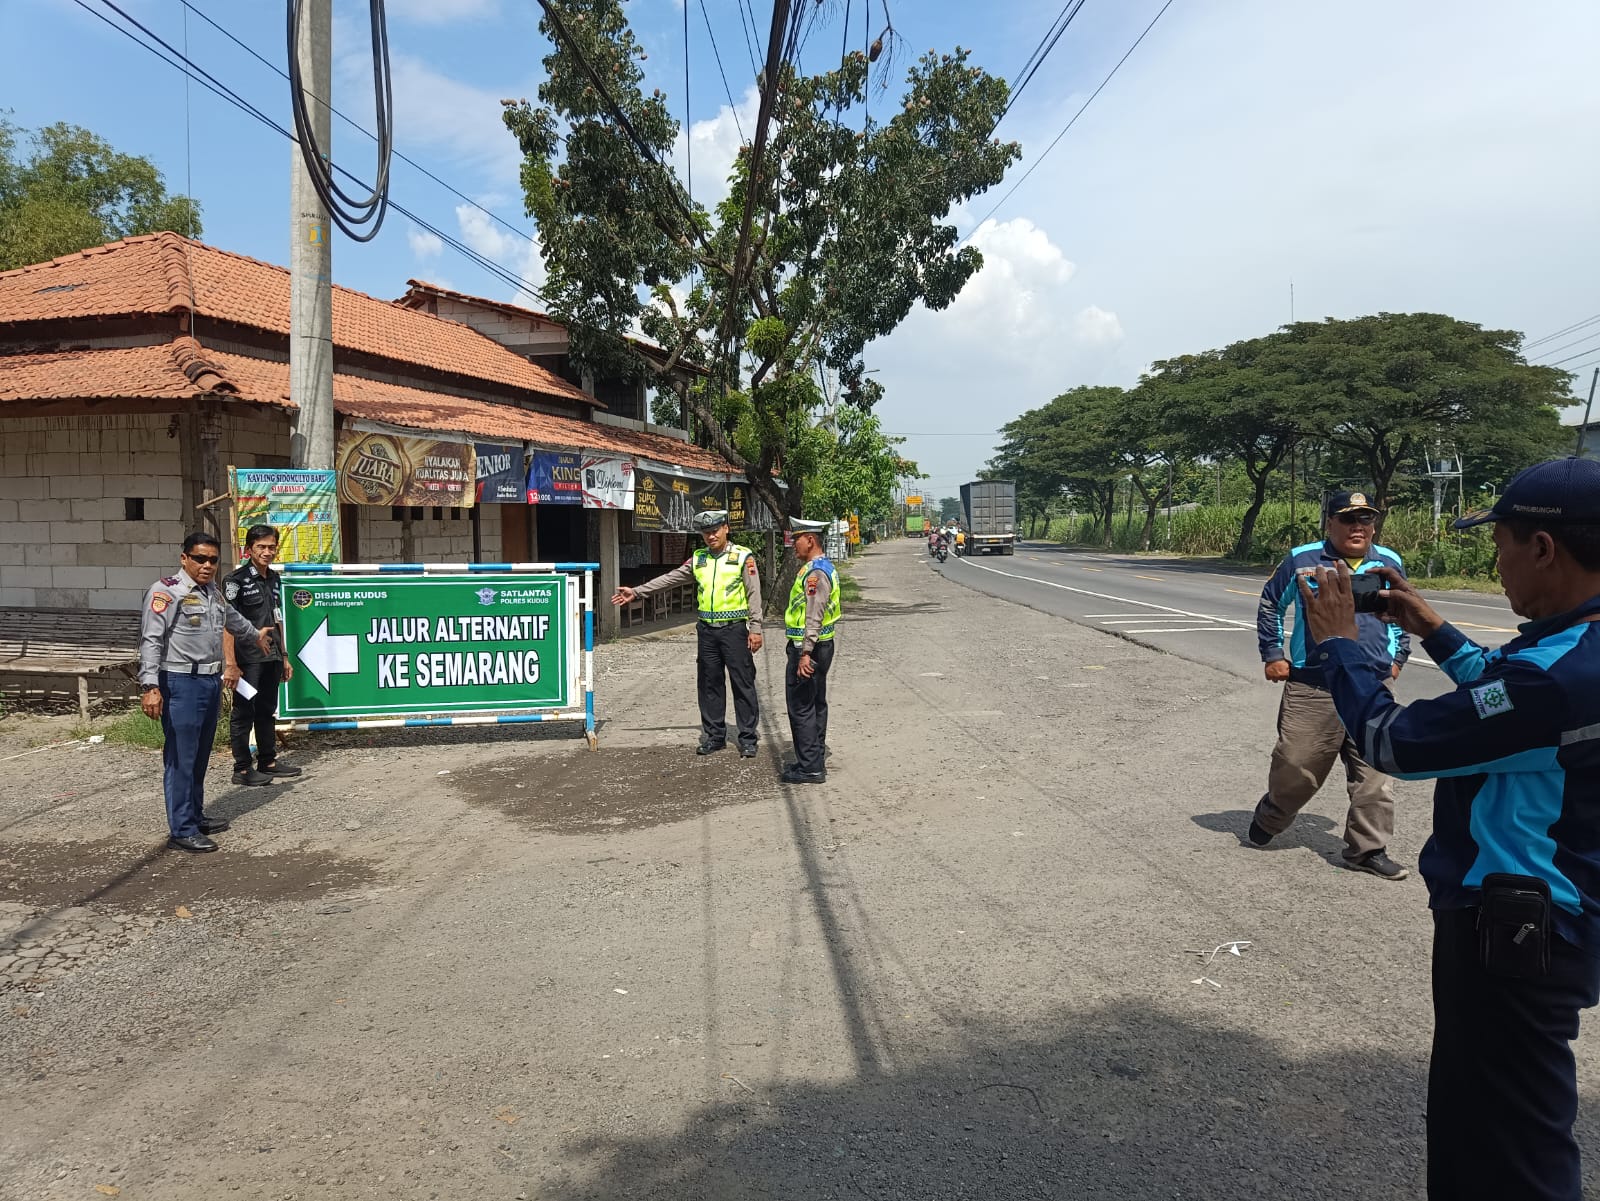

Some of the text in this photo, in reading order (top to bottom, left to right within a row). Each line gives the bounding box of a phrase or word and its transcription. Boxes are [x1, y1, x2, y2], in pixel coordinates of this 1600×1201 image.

[351, 456, 394, 483] JUARA
[476, 453, 511, 477] ENIOR
[247, 473, 275, 483] KAVLING
[415, 468, 449, 480] KUALITAS
[551, 465, 581, 481] KING
[638, 492, 656, 505] SUPER
[314, 591, 388, 600] DISHUB KUDUS
[500, 589, 552, 598] SATLANTAS
[500, 597, 526, 605] POLRES
[366, 615, 550, 644] JALUR ALTERNATIF
[377, 650, 541, 689] KE SEMARANG
